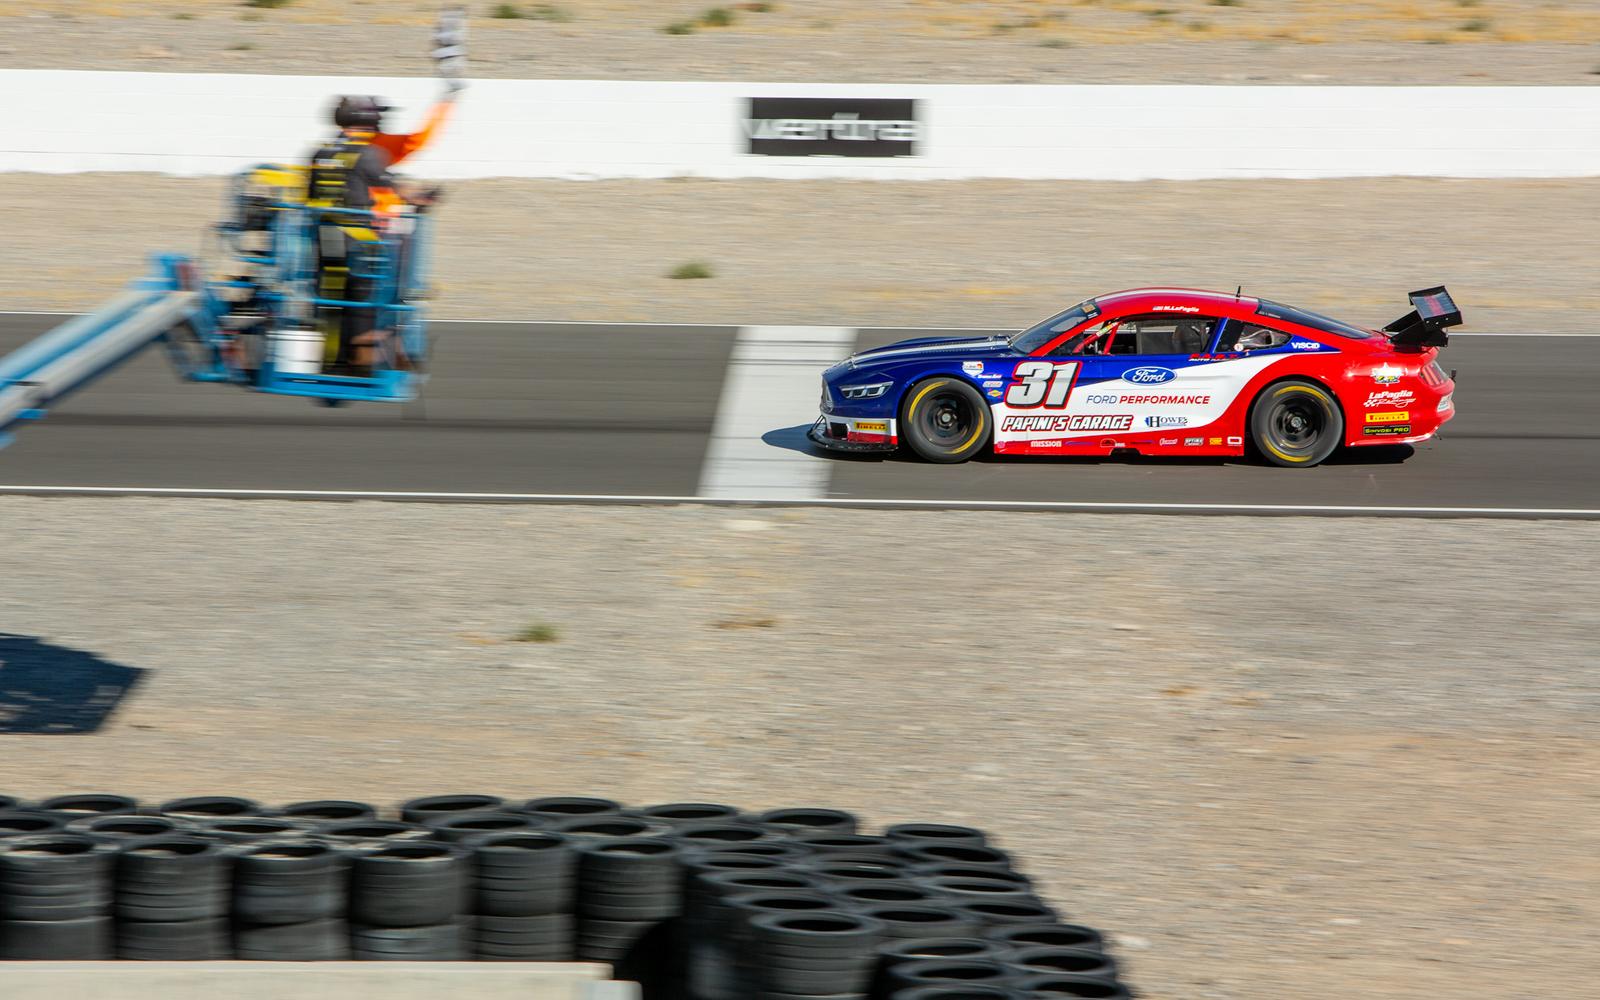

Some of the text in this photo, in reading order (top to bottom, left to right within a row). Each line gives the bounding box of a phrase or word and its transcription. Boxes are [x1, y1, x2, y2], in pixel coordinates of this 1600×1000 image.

[1132, 369, 1167, 382] Ford
[1005, 361, 1081, 408] 31
[1086, 395, 1211, 404] FORD PERFORMANCE
[1369, 390, 1413, 399] LaPaglia
[1001, 415, 1133, 431] PAPINI'S GARAGE
